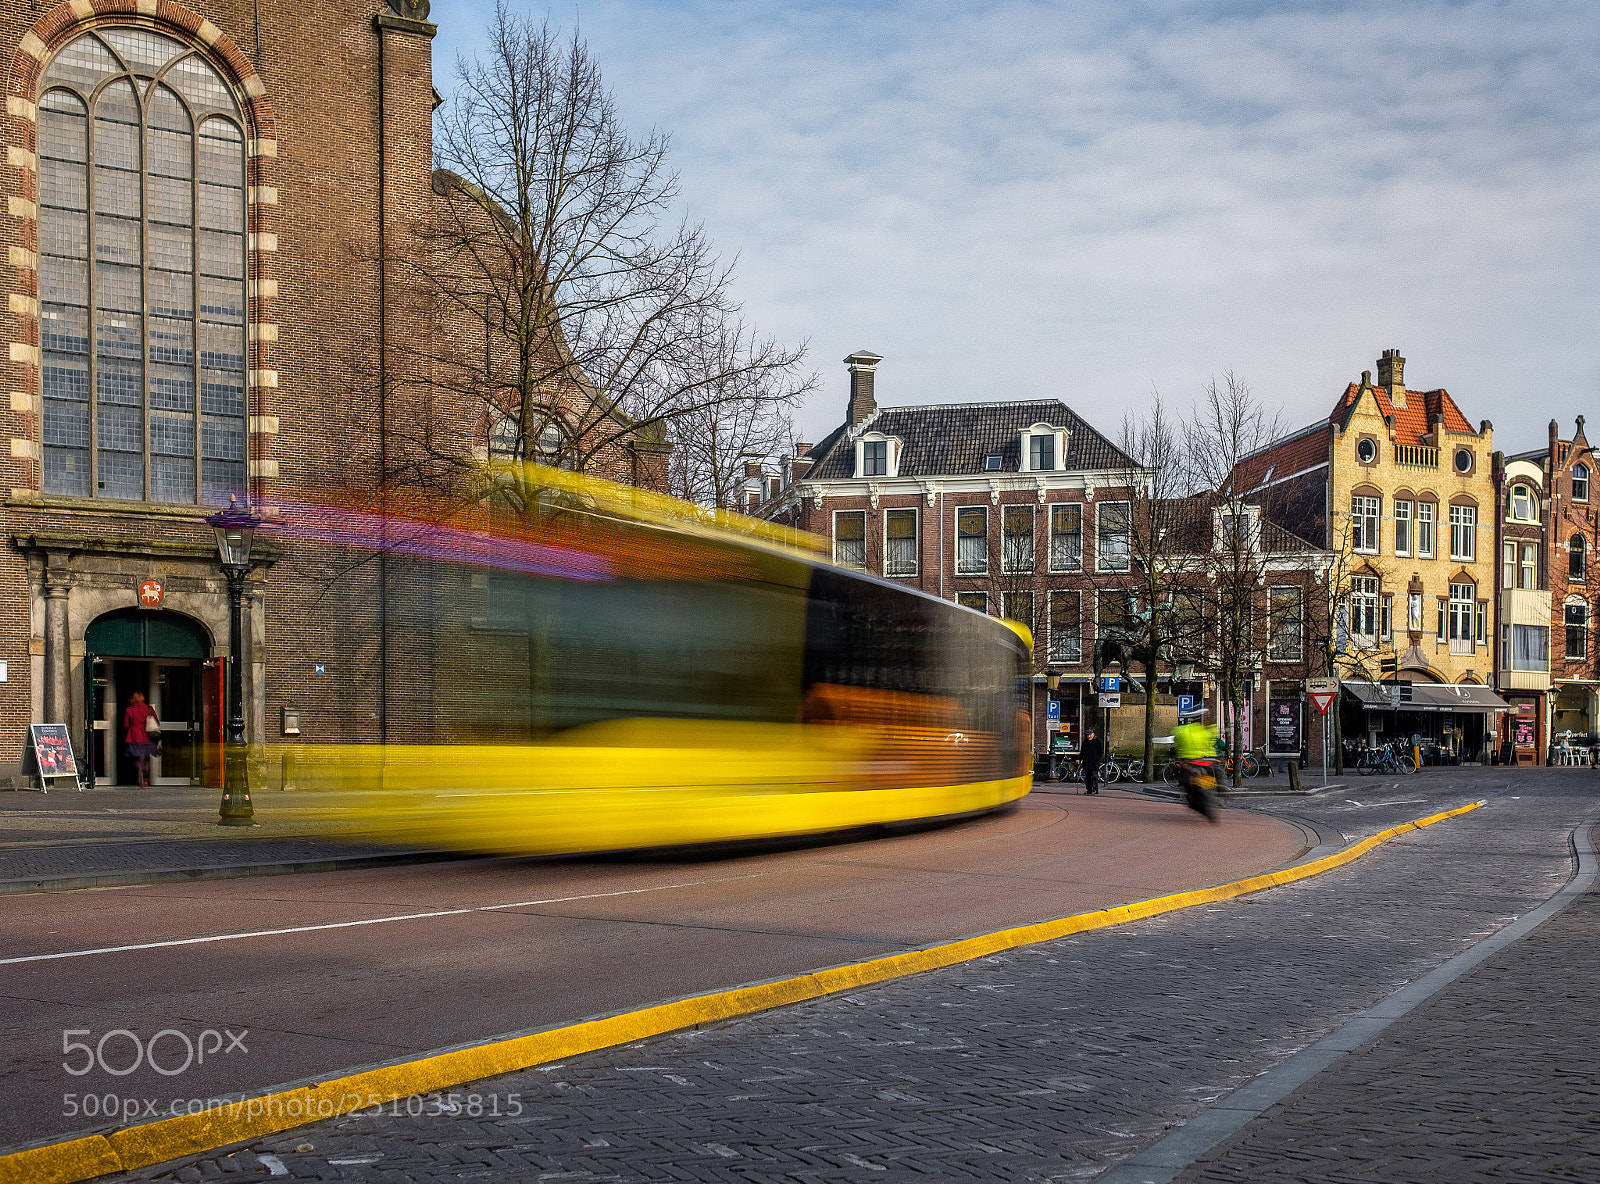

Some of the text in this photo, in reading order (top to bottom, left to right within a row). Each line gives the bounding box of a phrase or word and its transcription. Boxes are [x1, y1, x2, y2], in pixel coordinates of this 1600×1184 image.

[1109, 678, 1116, 686] P
[1050, 702, 1057, 713] P
[1181, 697, 1190, 709] P
